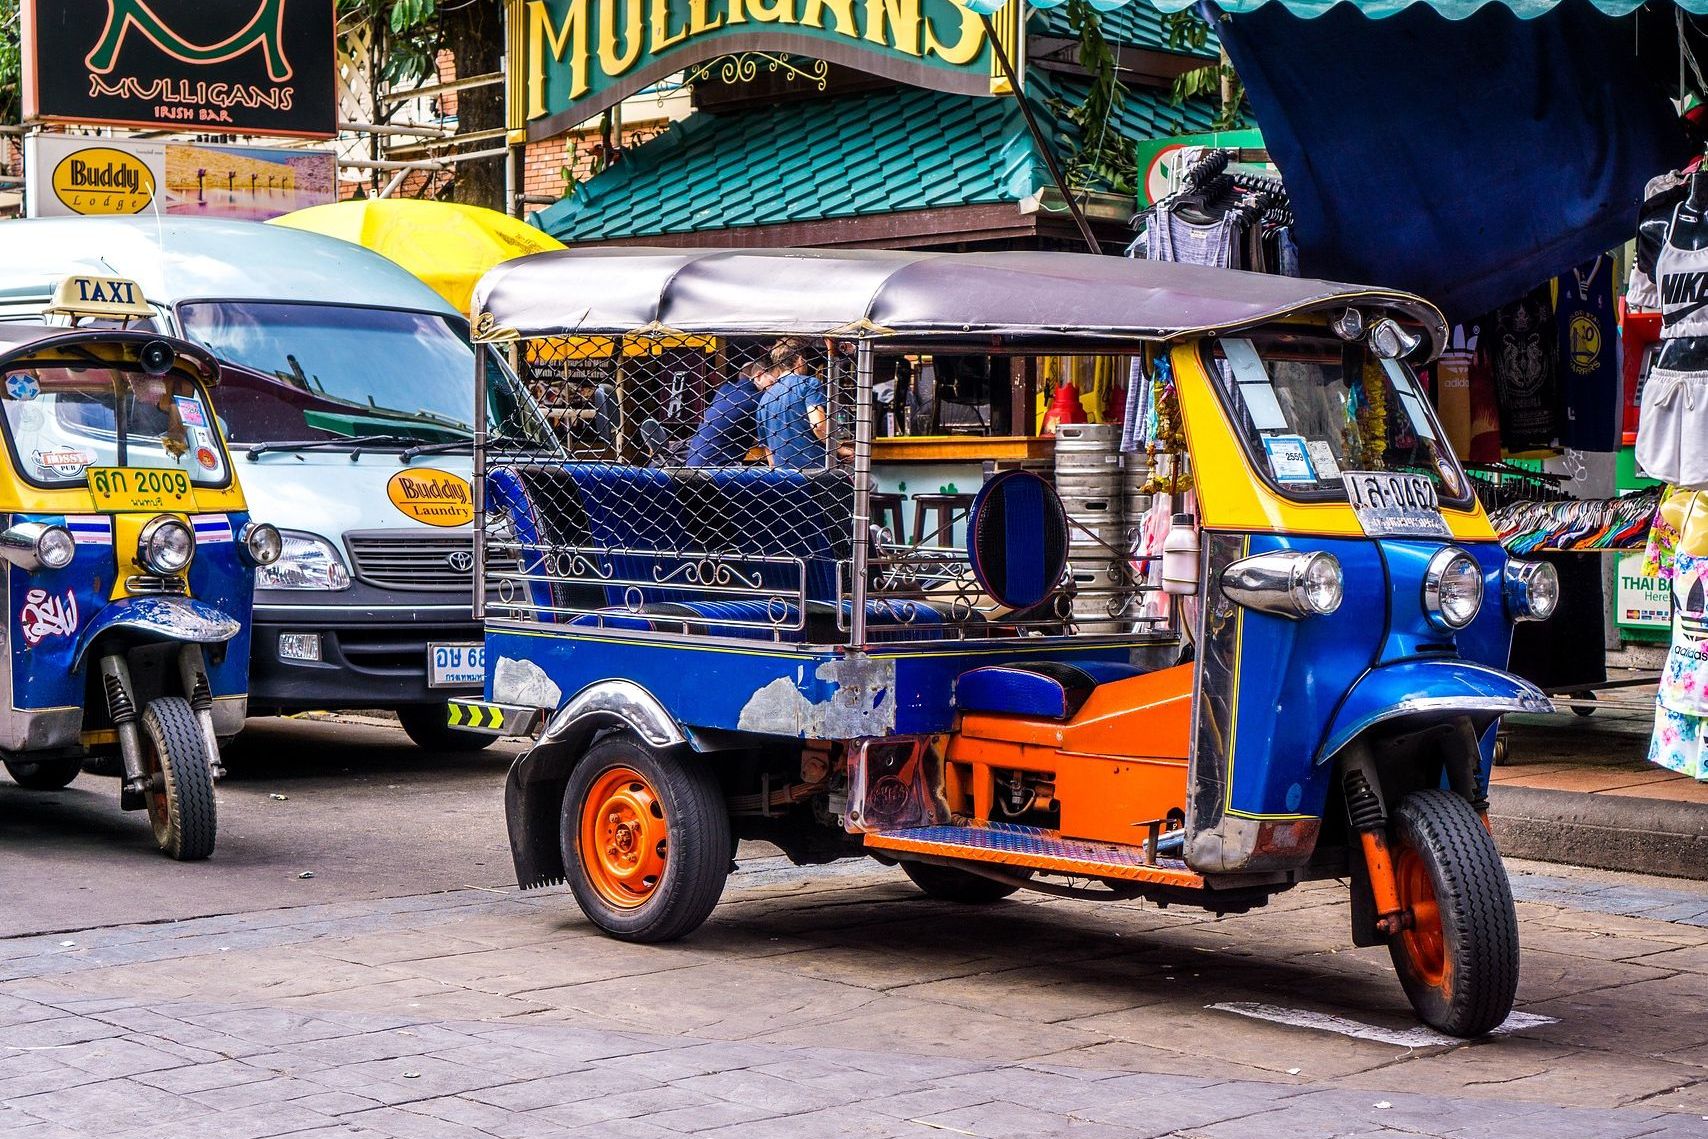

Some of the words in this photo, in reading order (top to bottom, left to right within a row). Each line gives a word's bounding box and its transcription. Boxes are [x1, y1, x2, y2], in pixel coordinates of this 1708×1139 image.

[89, 74, 295, 111] MULLIGANS
[154, 106, 194, 120] IRISH
[199, 109, 233, 123] BAR
[71, 159, 139, 194] Buddy
[73, 195, 137, 211] Lodge
[75, 279, 136, 304] TAXI
[1286, 452, 1304, 462] 2559
[135, 471, 188, 494] 2009
[399, 477, 467, 504] Buddy
[413, 506, 468, 517] Laundry
[1622, 576, 1654, 591] THAI
[1645, 591, 1669, 601] Here
[1674, 644, 1708, 662] adidas
